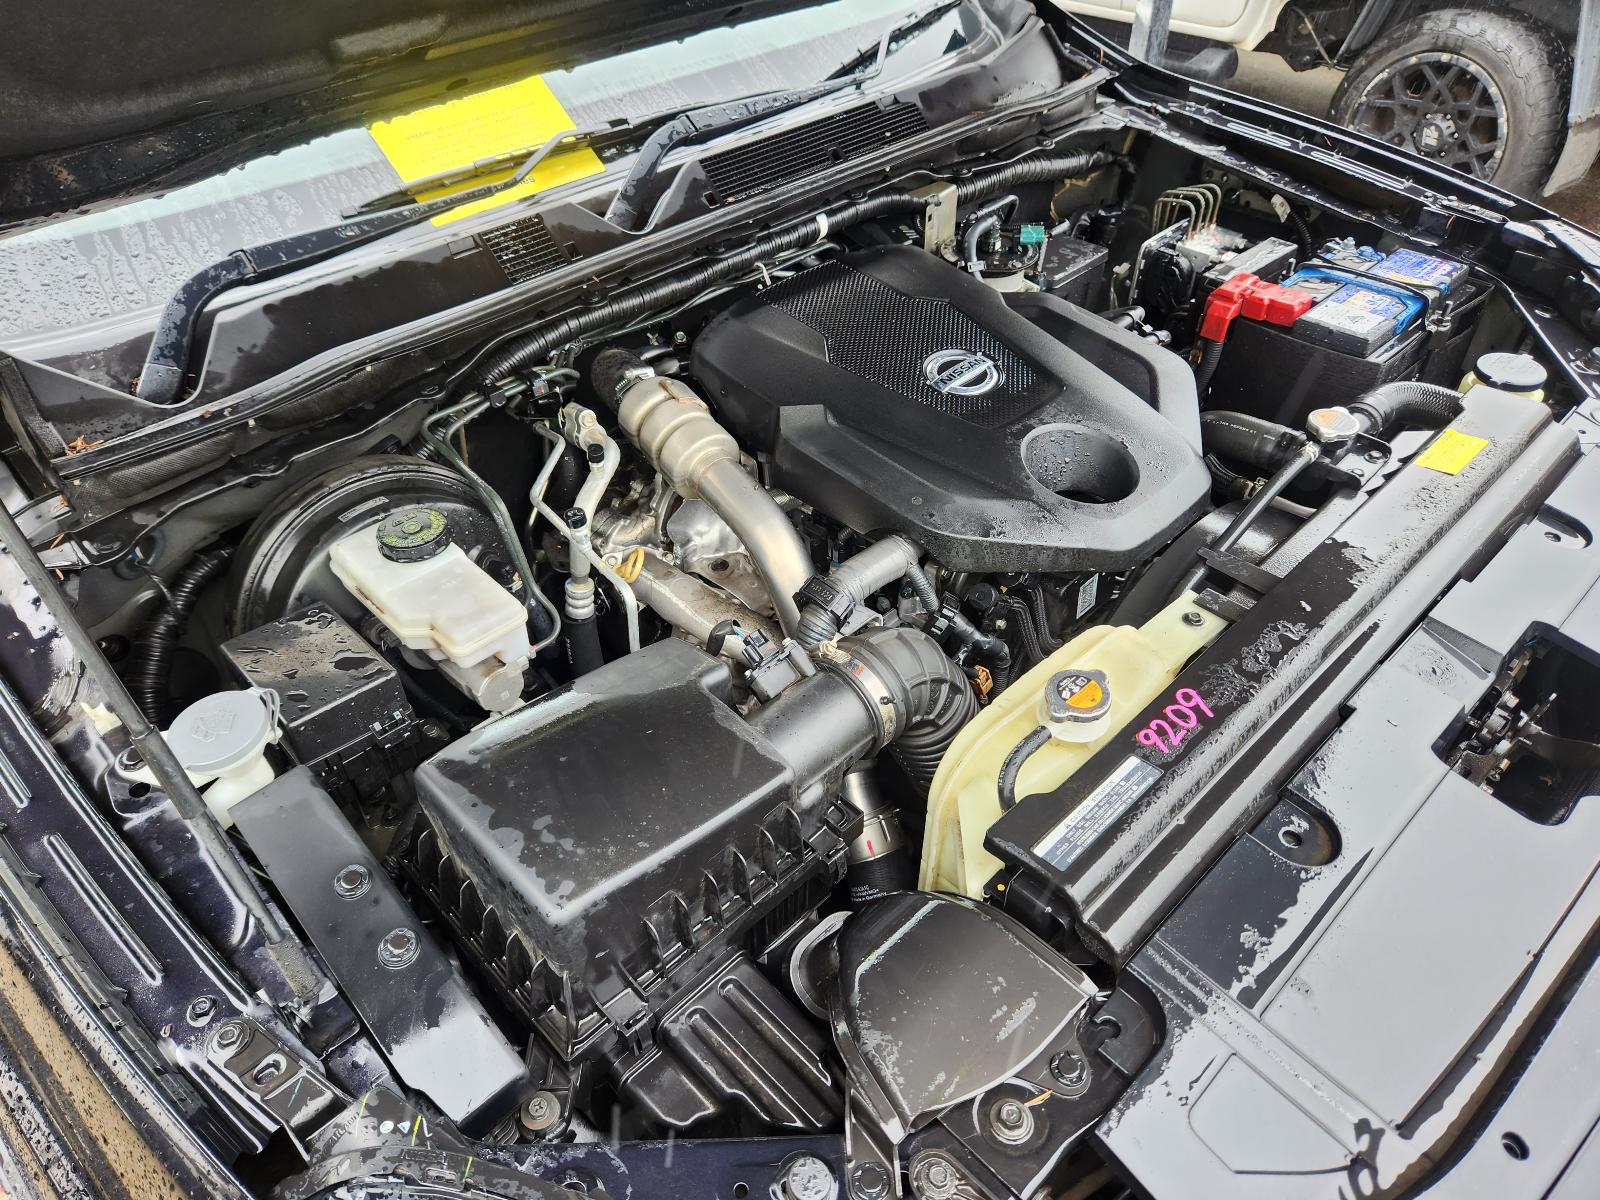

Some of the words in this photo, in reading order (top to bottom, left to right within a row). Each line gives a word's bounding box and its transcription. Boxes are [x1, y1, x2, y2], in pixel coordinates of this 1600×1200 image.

[939, 357, 987, 385] NISSAN
[1135, 688, 1214, 754] 9209
[1069, 802, 1090, 823] CAUTION
